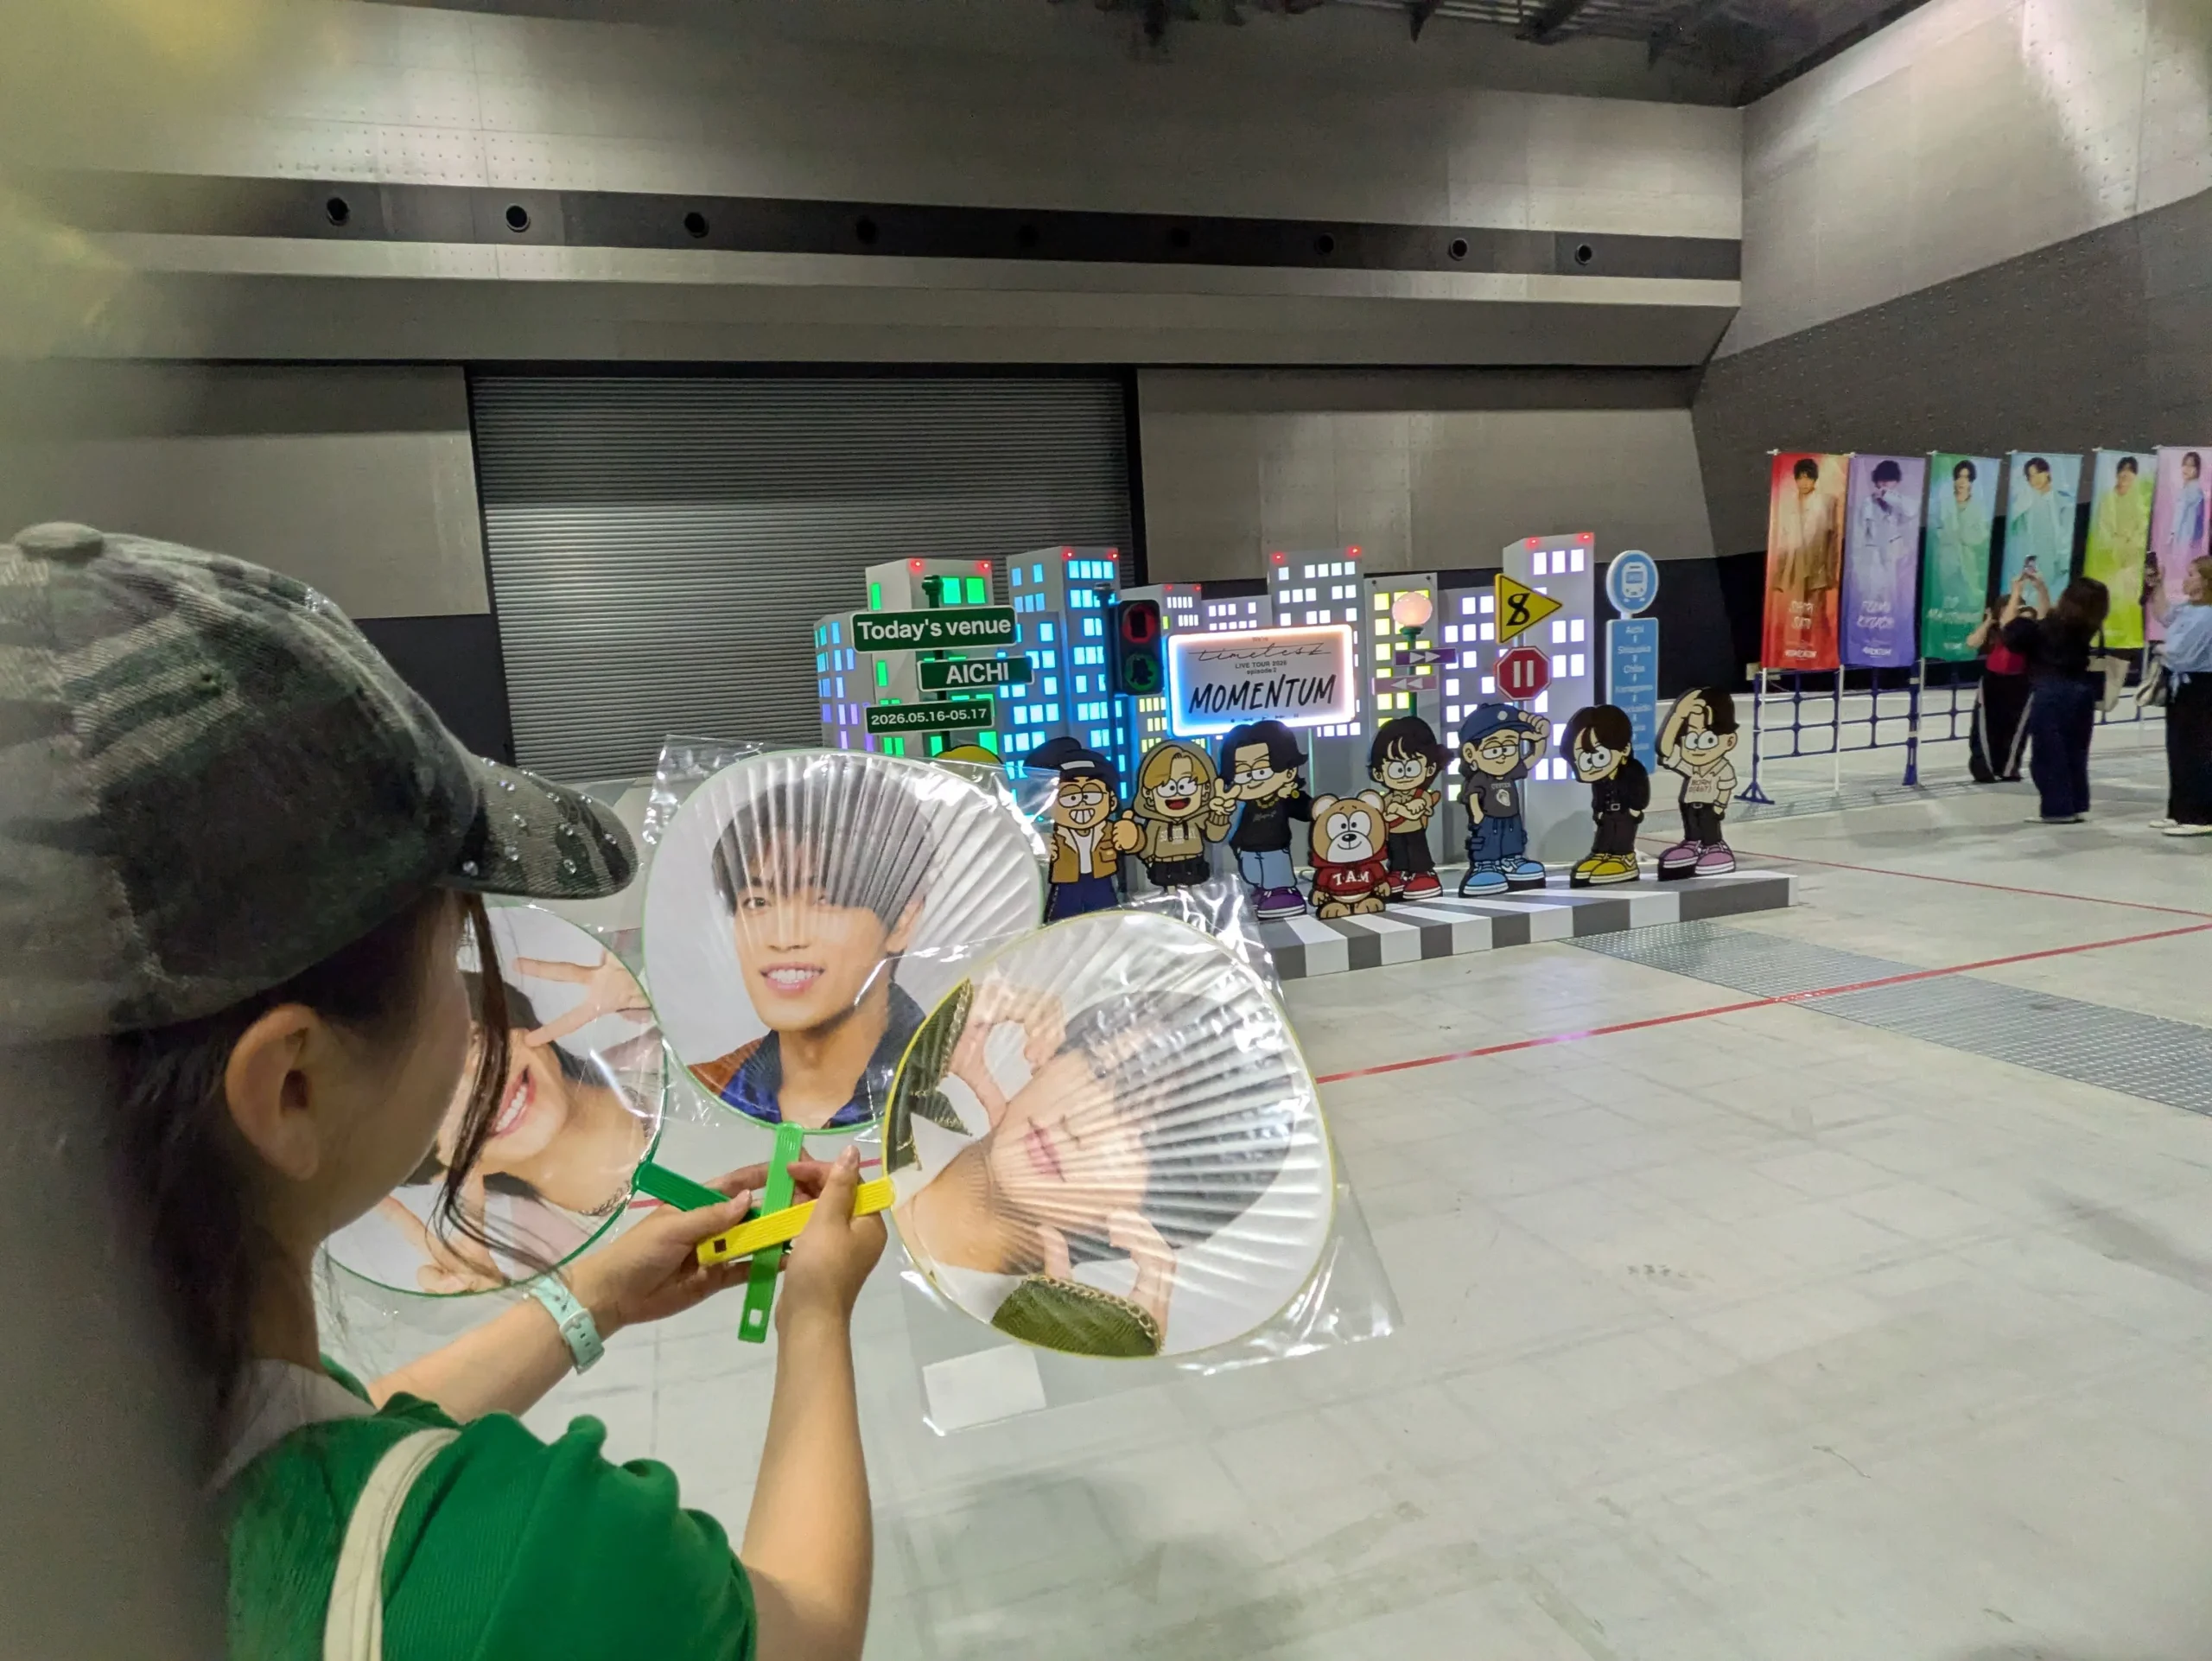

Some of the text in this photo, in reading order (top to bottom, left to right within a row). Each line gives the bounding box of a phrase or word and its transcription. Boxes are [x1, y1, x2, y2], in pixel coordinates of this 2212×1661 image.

[857, 619, 1011, 641] Today's venue
[946, 662, 1009, 684] AICHI
[1189, 674, 1337, 714] MOMENTUM
[871, 708, 987, 726] 2026.05.16-05.17
